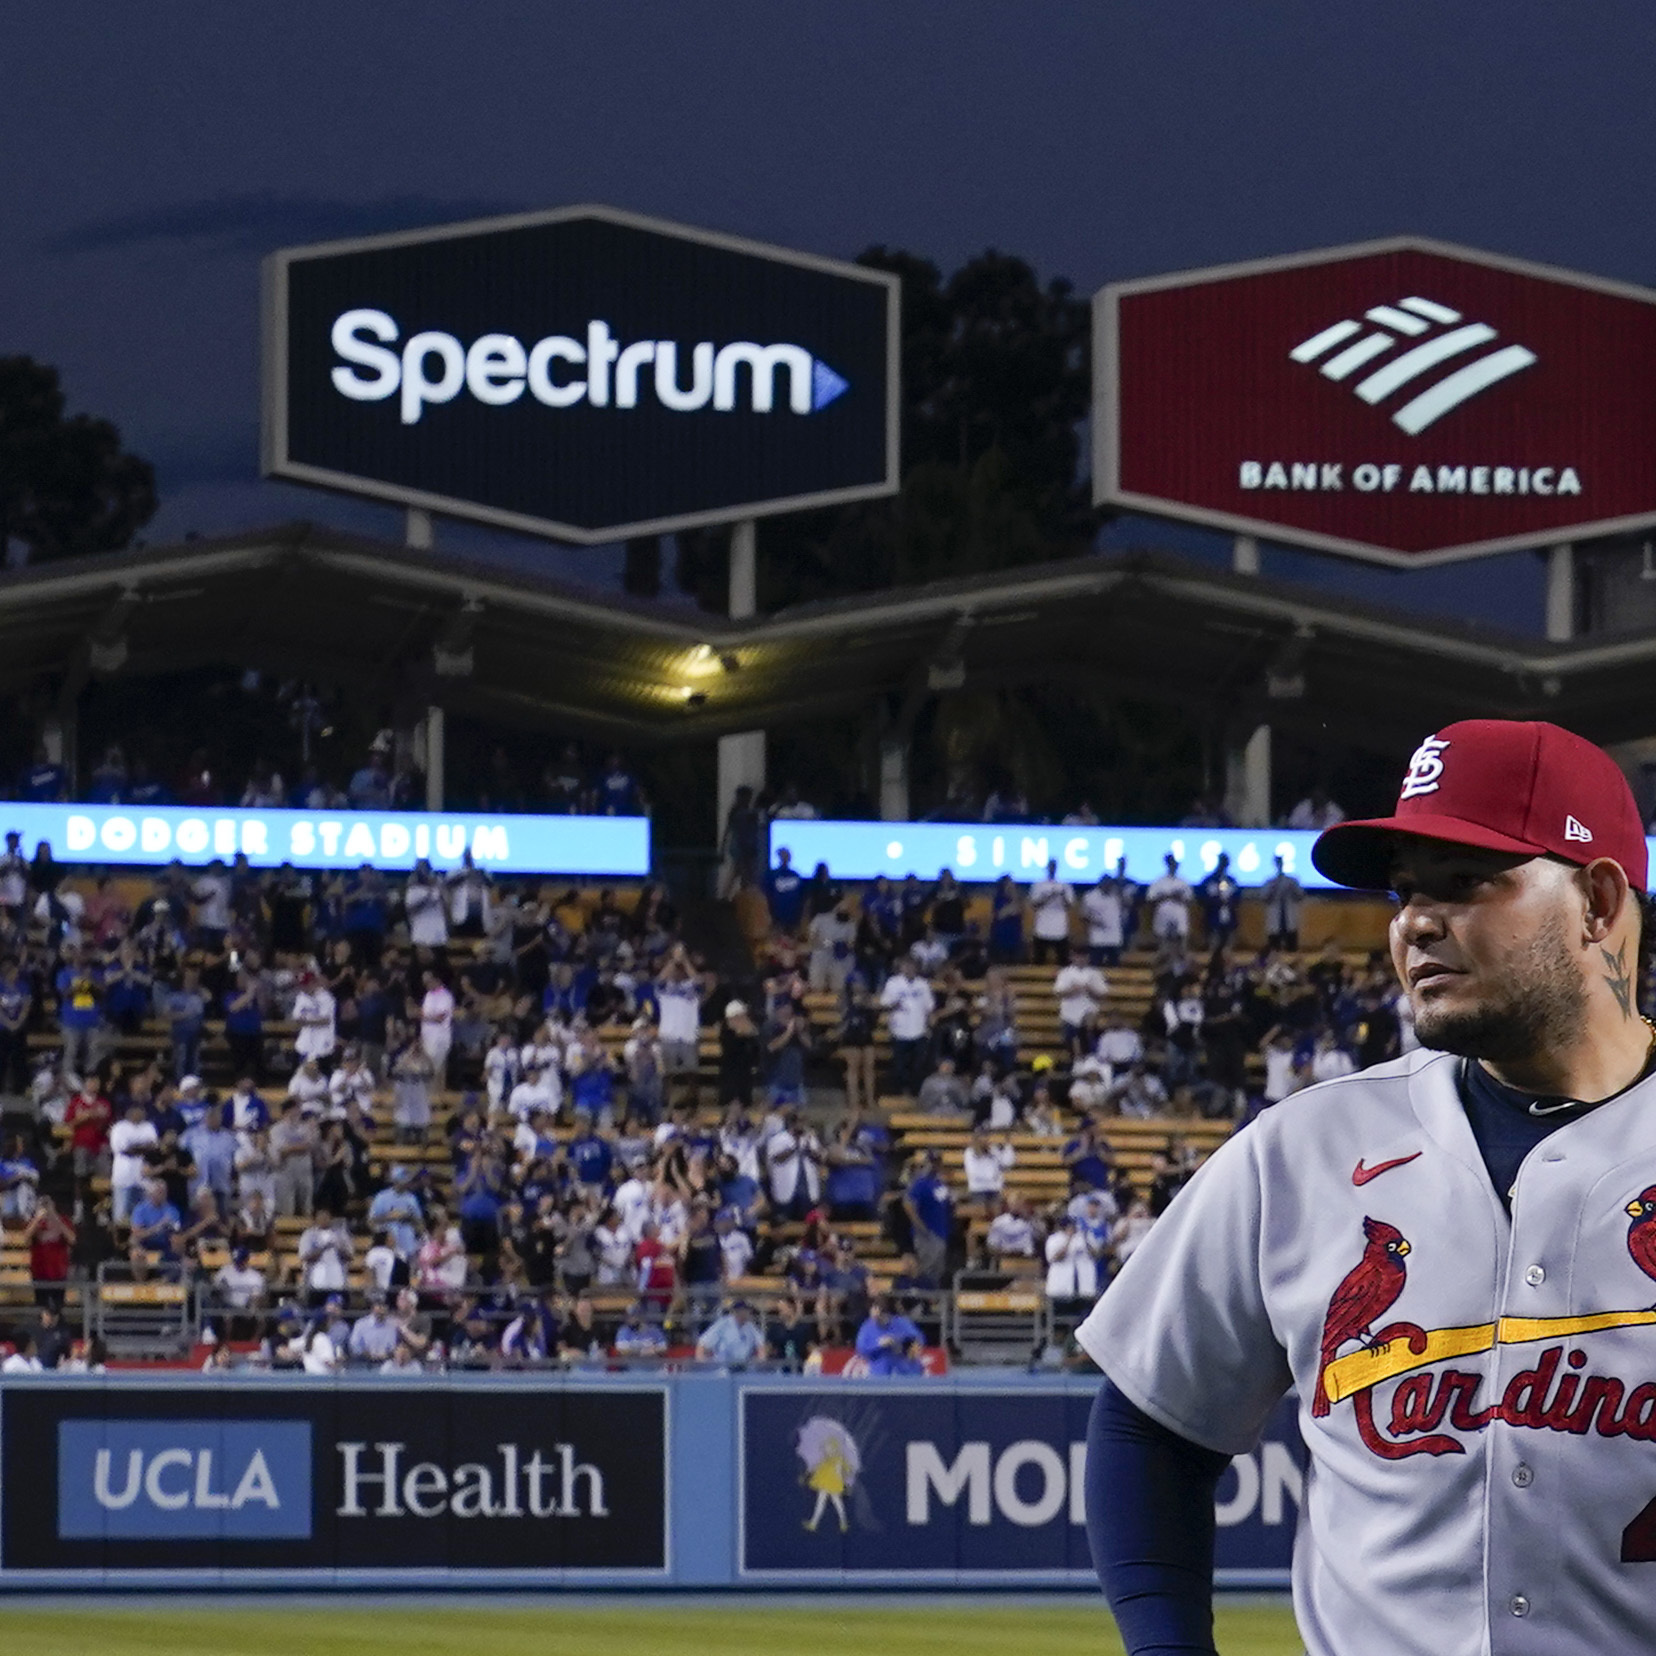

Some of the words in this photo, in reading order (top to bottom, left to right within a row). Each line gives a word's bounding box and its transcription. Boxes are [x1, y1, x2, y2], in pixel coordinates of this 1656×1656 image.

[330, 308, 814, 425] Spectrum
[1239, 460, 1343, 490] BANK
[1352, 463, 1401, 492] OF
[1409, 464, 1583, 495] AMERICA
[65, 814, 270, 856] DODGER
[288, 819, 511, 862] STADIUM
[954, 834, 1128, 872] SINCE
[1168, 838, 1298, 875] 1962
[93, 1449, 280, 1508] UCLA
[336, 1442, 609, 1517] Health
